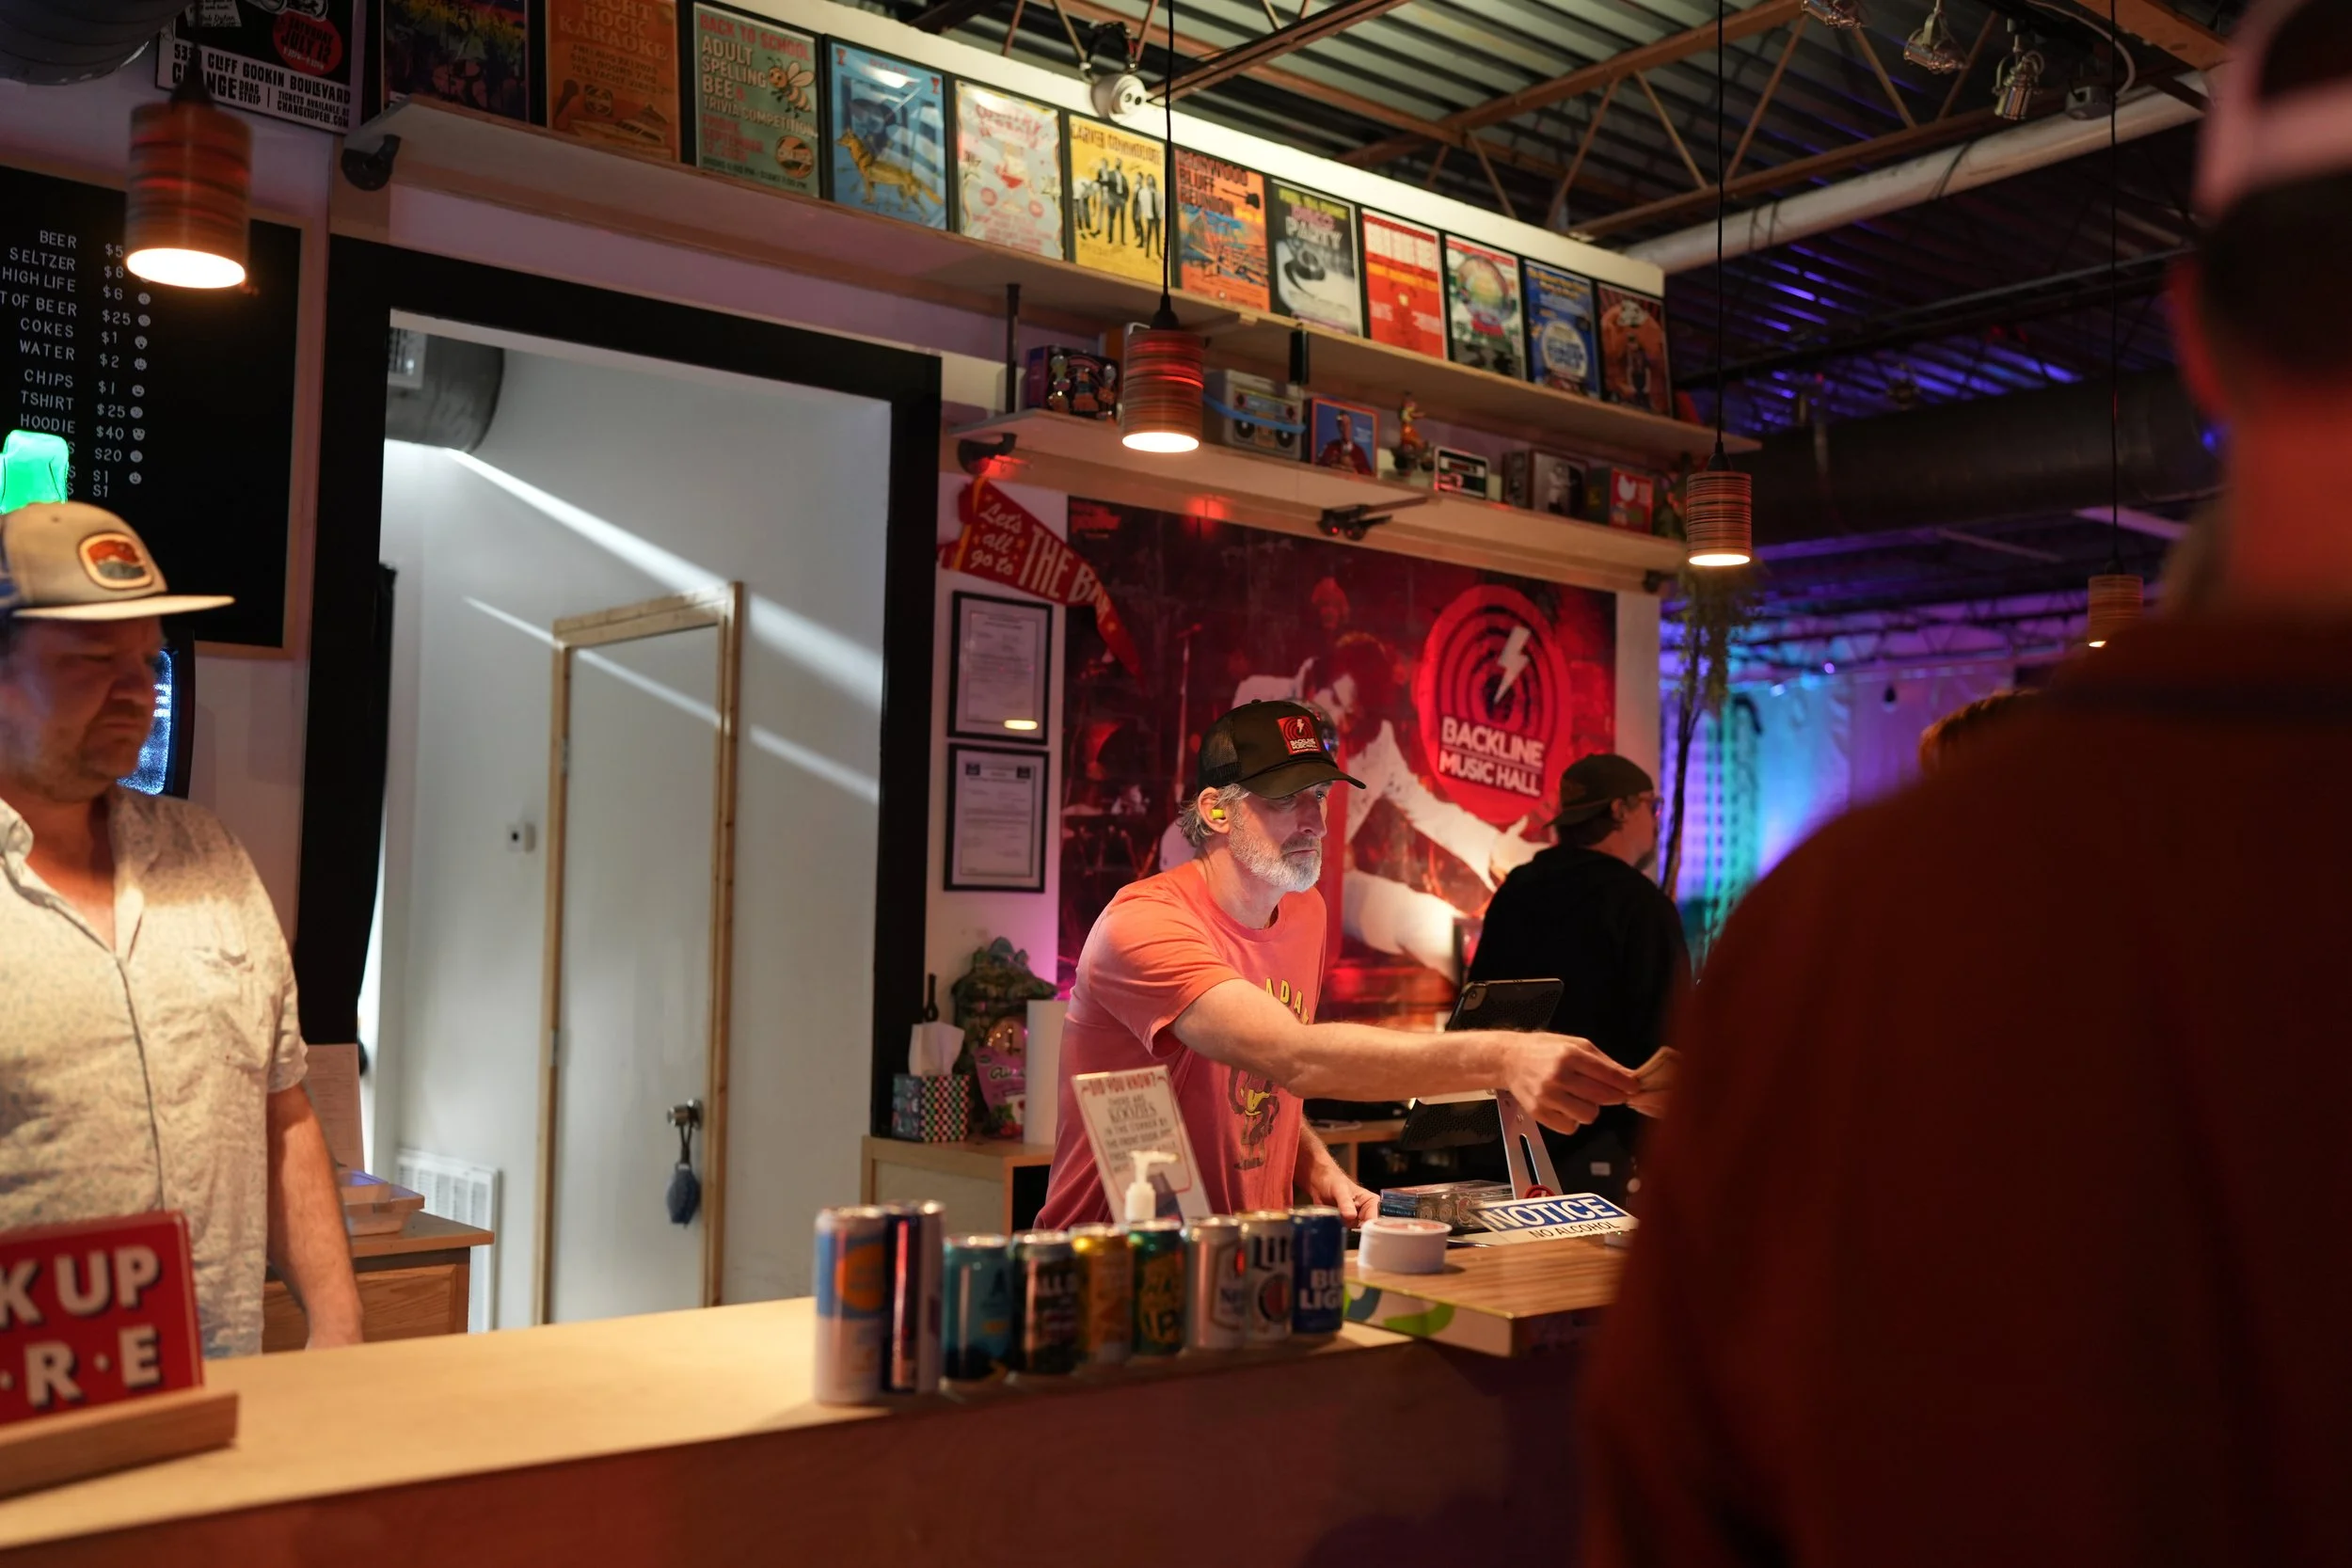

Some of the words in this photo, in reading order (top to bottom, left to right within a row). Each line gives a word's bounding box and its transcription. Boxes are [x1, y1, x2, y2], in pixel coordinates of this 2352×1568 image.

[583, 3, 646, 37] ROCK
[700, 14, 735, 38] BACK
[739, 24, 756, 44] TO
[280, 33, 312, 56] JULY
[317, 41, 332, 64] 12
[560, 15, 668, 60] KARAOKE
[702, 36, 753, 66] ADULT
[172, 63, 238, 100] CNGE
[239, 81, 260, 95] DRAG
[208, 53, 238, 74] CLIFF
[243, 62, 284, 87] BOOKIN
[290, 75, 351, 103] BOULEVARD
[702, 56, 768, 88] SPELLING
[703, 72, 734, 99] BEE
[238, 90, 262, 104] STRIP
[278, 90, 304, 105] TICKETS
[704, 95, 739, 118] TRIVIA
[40, 230, 77, 248] BEER
[104, 243, 124, 259] $5
[1285, 216, 1343, 250] PARTY
[9, 247, 76, 271] SELTZER
[103, 265, 124, 279] $6
[2, 267, 40, 286] HIGH
[43, 275, 76, 293] LIFE
[103, 285, 123, 301] $6
[11, 293, 30, 309] OF
[36, 297, 77, 317] BEER
[103, 309, 132, 325] $25
[20, 317, 74, 338] COKES
[102, 331, 118, 345] $1
[19, 340, 75, 361] WATER
[100, 353, 119, 368] $2
[24, 369, 74, 388] CHIPS
[98, 380, 115, 395] $1
[21, 390, 74, 411] TSHIRT
[97, 403, 126, 419] $25
[20, 414, 76, 435] HOODIE
[96, 425, 124, 441] $40
[978, 502, 1022, 534] Let's
[982, 532, 1014, 555] all
[969, 549, 994, 569] go
[995, 557, 1014, 575] to
[1017, 524, 1075, 599] THE
[1441, 717, 1545, 768] BACKLINE
[1439, 751, 1494, 784] MUSIC
[1496, 764, 1541, 797] HALL
[1480, 1198, 1617, 1229] NOTICE
[1528, 1229, 1554, 1239] NO
[1555, 1221, 1620, 1235] ALCOHOL
[1311, 1269, 1343, 1290] BU
[1298, 1289, 1343, 1309] LIG
